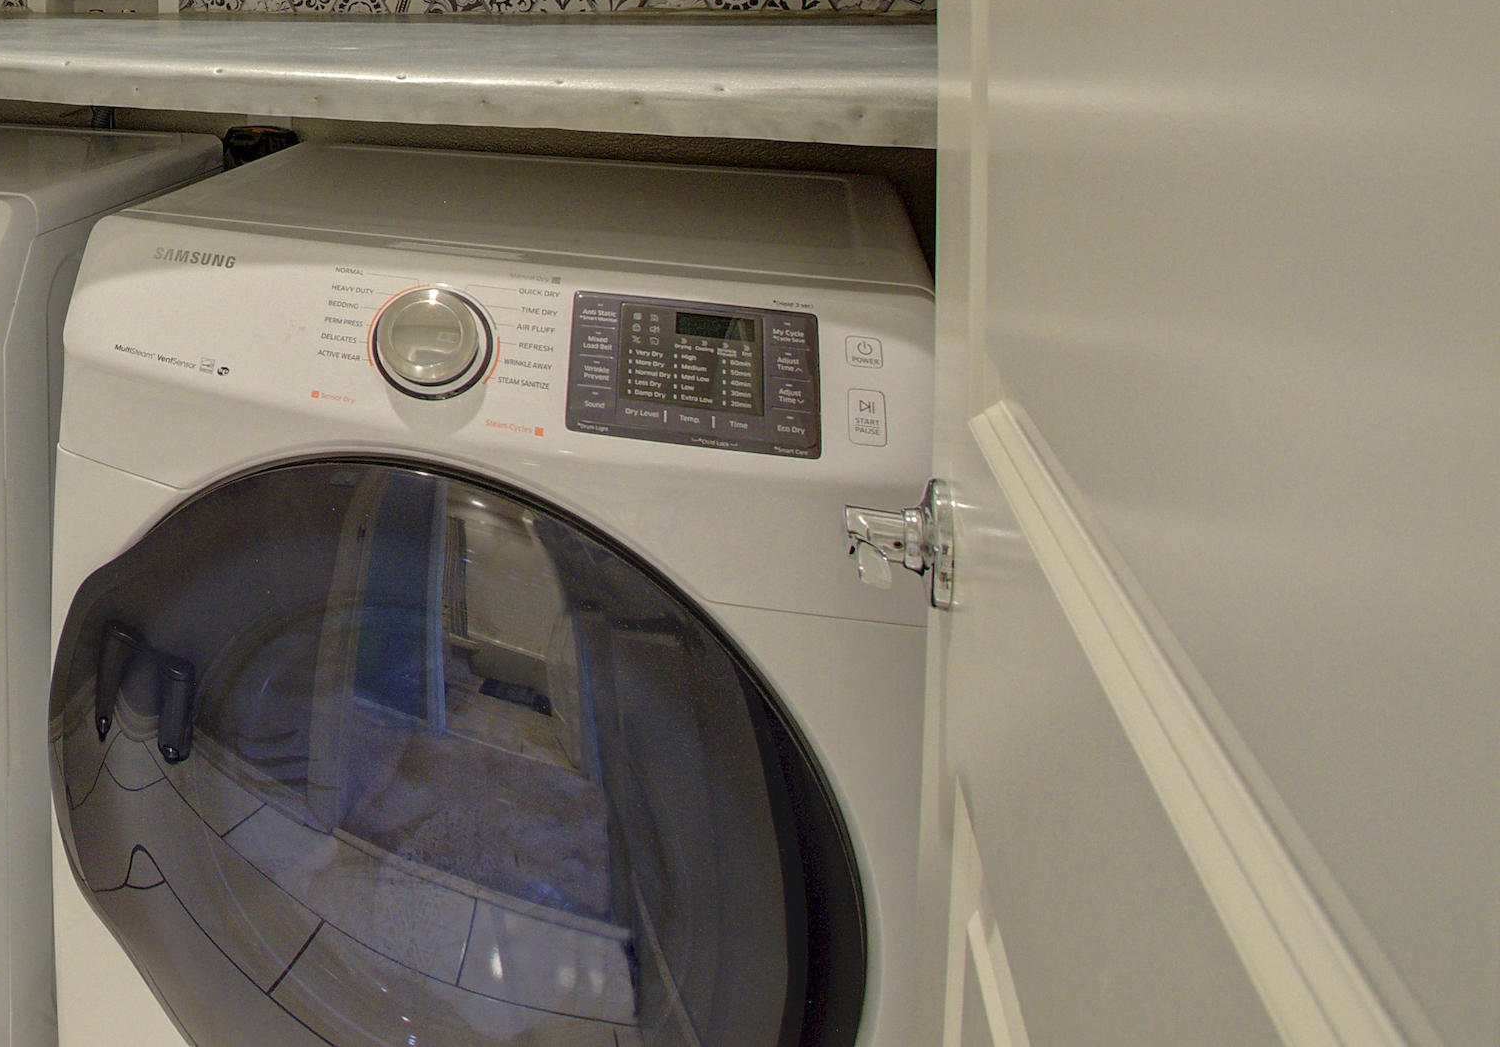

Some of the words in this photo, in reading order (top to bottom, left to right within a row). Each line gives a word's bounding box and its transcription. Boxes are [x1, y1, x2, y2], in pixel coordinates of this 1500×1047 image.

[154, 247, 236, 269] SAMSUNG
[335, 266, 364, 276] NORMAL
[331, 284, 353, 293] HEAVY
[355, 287, 374, 295] DUTY
[518, 287, 542, 297] QUICK
[544, 289, 560, 298] DRY
[328, 299, 359, 310] BEDDING
[521, 306, 541, 315] TIME
[542, 308, 558, 317] DRY
[324, 316, 342, 325] PERM
[343, 318, 364, 327] PRESS
[516, 322, 530, 331] AIR
[532, 324, 556, 334] FLUFF
[320, 332, 357, 344] DELICATES
[518, 341, 554, 353] REFRESH
[317, 349, 339, 360] ACTIVE
[341, 352, 361, 362] WEAR
[851, 356, 880, 365] POWER
[157, 354, 197, 369] VentSensor
[504, 358, 531, 368] WRINKLE
[532, 360, 552, 371] AWAY
[498, 376, 520, 385] STEAM
[521, 379, 550, 390] SANITIZE
[344, 395, 355, 404] Dry
[584, 400, 605, 409] Sound
[625, 407, 638, 417] Dry
[639, 409, 659, 418] Level
[485, 419, 508, 430] Steam
[509, 422, 533, 434] Cycles
[729, 420, 749, 429] Time
[855, 417, 879, 425] START
[777, 424, 790, 433] Eco
[791, 425, 805, 435] Dry
[855, 426, 880, 436] PAUSE
